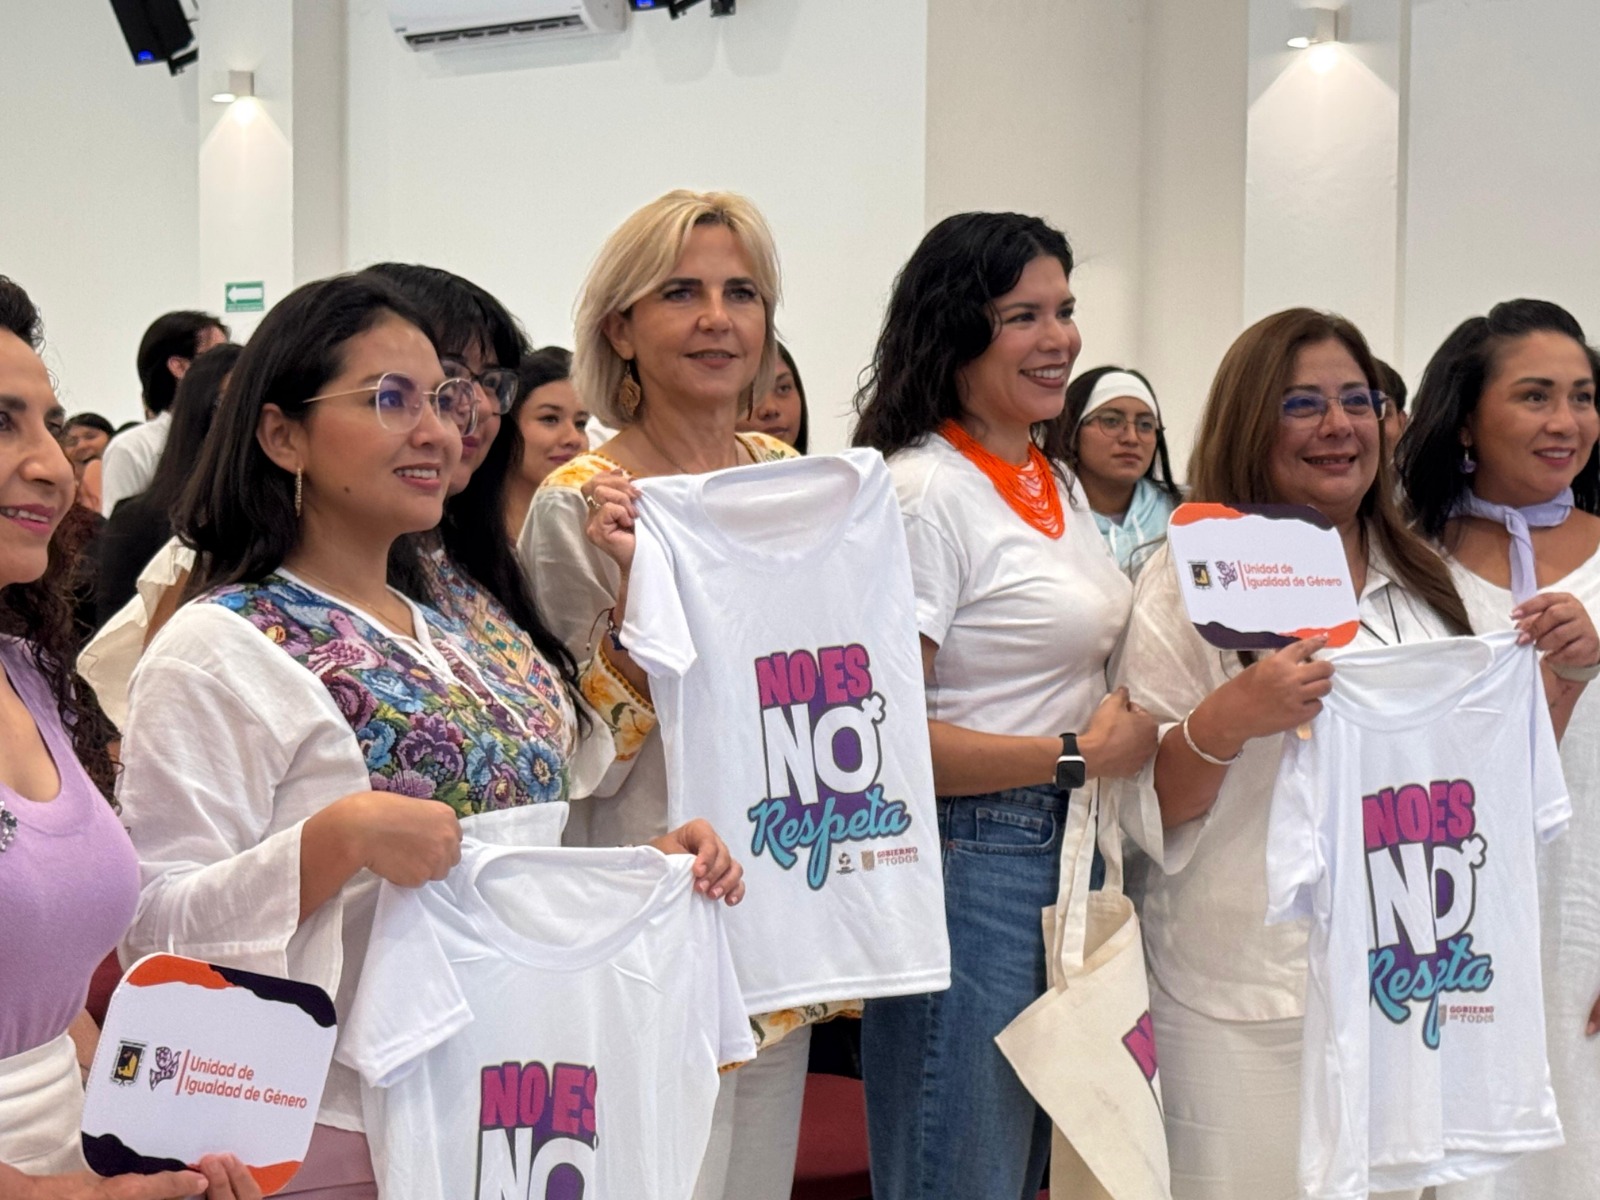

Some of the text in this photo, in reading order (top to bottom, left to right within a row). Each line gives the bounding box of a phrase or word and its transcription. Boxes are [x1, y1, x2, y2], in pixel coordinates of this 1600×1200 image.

[1243, 563, 1293, 575] Unidad de
[1246, 575, 1343, 590] Igualdad de Género
[755, 643, 873, 707] NO ES
[761, 702, 883, 806] NO
[748, 784, 912, 891] Respeta
[1362, 779, 1476, 849] NO ES
[877, 846, 919, 858] GOBIERNO
[884, 854, 920, 866] TODOS
[184, 1075, 308, 1110] Igualdad de Género
[190, 1055, 255, 1081] Unidad de
[480, 1060, 550, 1129] NO
[474, 1127, 598, 1200] NO
